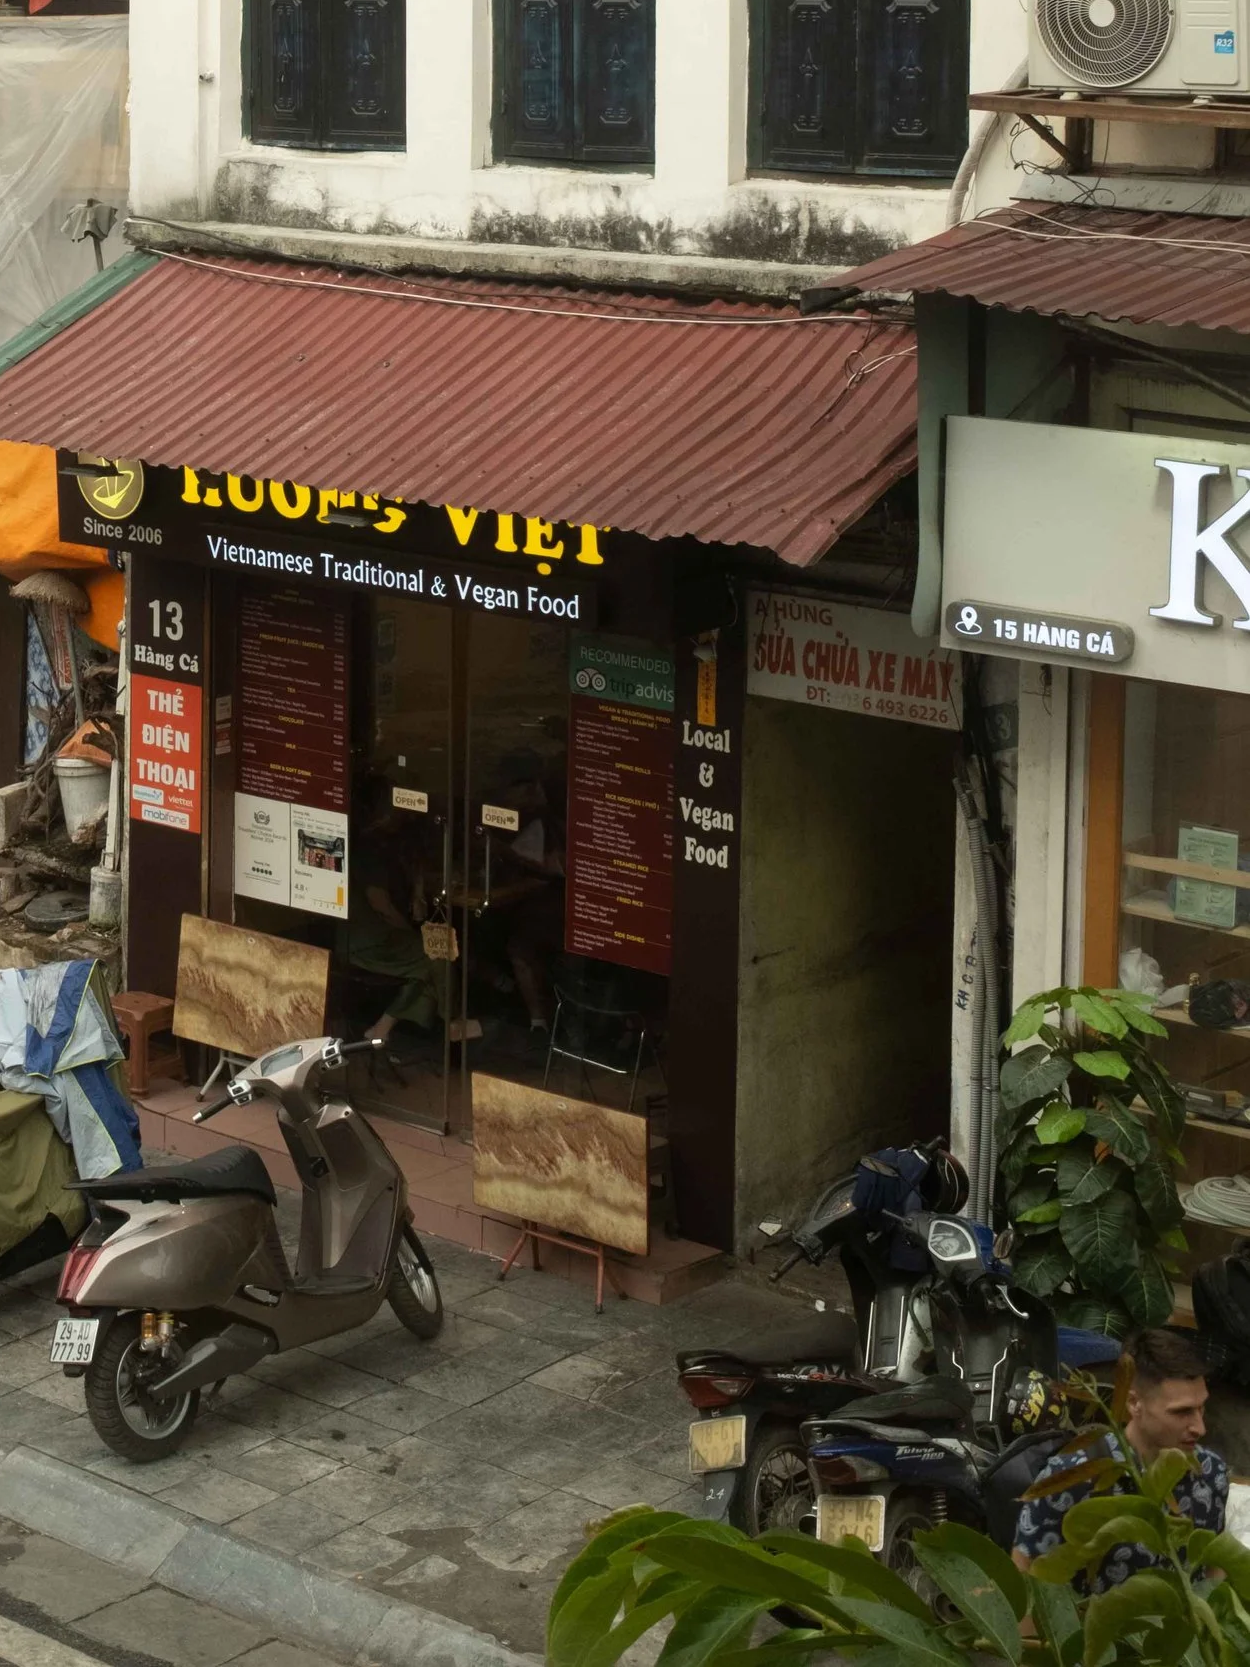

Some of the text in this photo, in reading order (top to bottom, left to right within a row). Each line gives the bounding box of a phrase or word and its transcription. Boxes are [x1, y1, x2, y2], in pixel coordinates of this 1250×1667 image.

[1216, 37, 1233, 48] R32
[83, 517, 163, 545] Since 2006
[207, 535, 580, 619] Vietnamese Traditional & Vegan Food
[148, 599, 184, 641] 13
[992, 618, 1115, 655] 15 HÀNG CÁ
[134, 644, 199, 673] Hàng Cá
[580, 644, 672, 676] RECOMMENDED
[864, 649, 898, 694] XE
[900, 650, 955, 703] MÁY
[147, 687, 184, 717] THẺ
[907, 702, 950, 724] 6226
[278, 714, 304, 725] CHOCOLATE
[142, 723, 190, 754] ĐIỆN
[682, 719, 731, 754] Local
[136, 758, 196, 793] THOẠI
[699, 762, 715, 788] &
[168, 795, 194, 808] viettel
[395, 795, 416, 807] OPEN
[679, 797, 735, 832] Vegan
[143, 806, 188, 826] mobifone
[485, 812, 507, 825] OPEN
[684, 836, 729, 869] Food
[52, 1342, 91, 1361] 777.99
